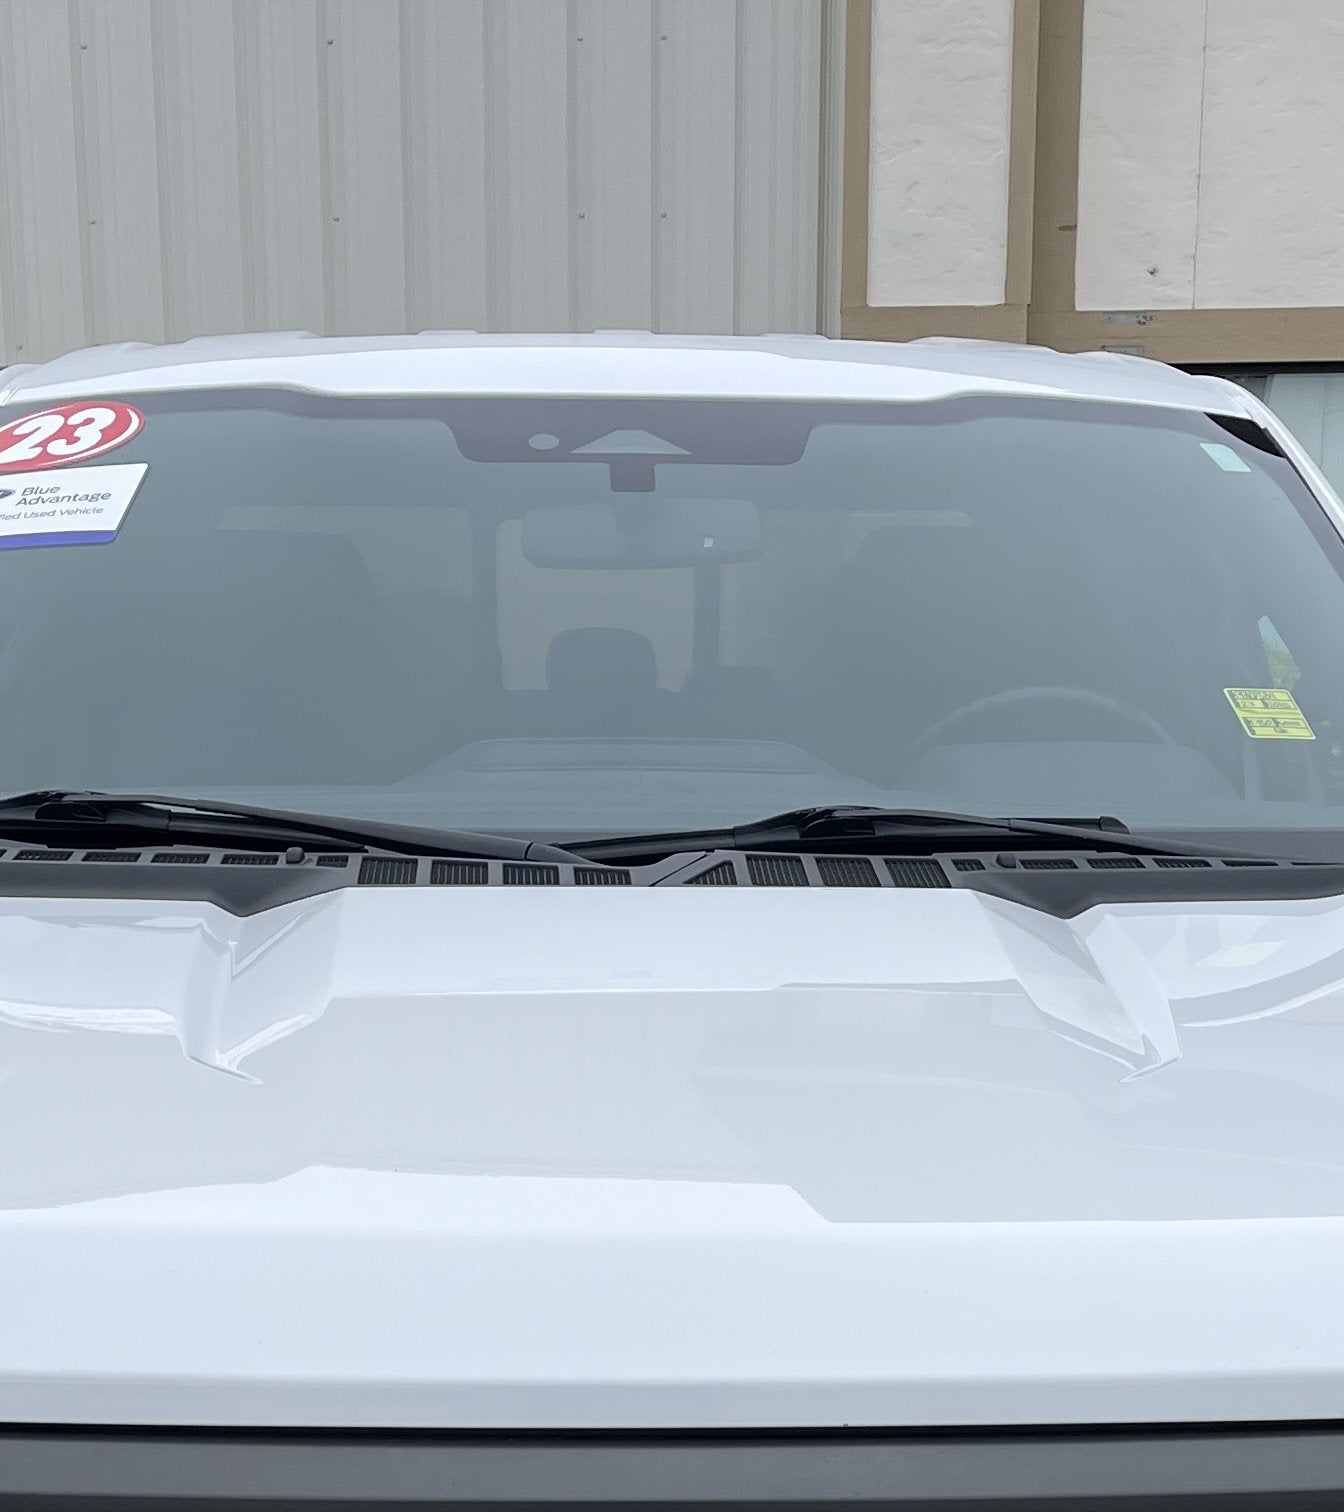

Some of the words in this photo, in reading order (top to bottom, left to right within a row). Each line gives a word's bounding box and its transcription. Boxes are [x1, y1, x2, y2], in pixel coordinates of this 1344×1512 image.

[20, 486, 61, 497] Blue
[15, 492, 112, 507] Advantage
[23, 509, 57, 519] Used
[60, 506, 105, 517] Vehicle
